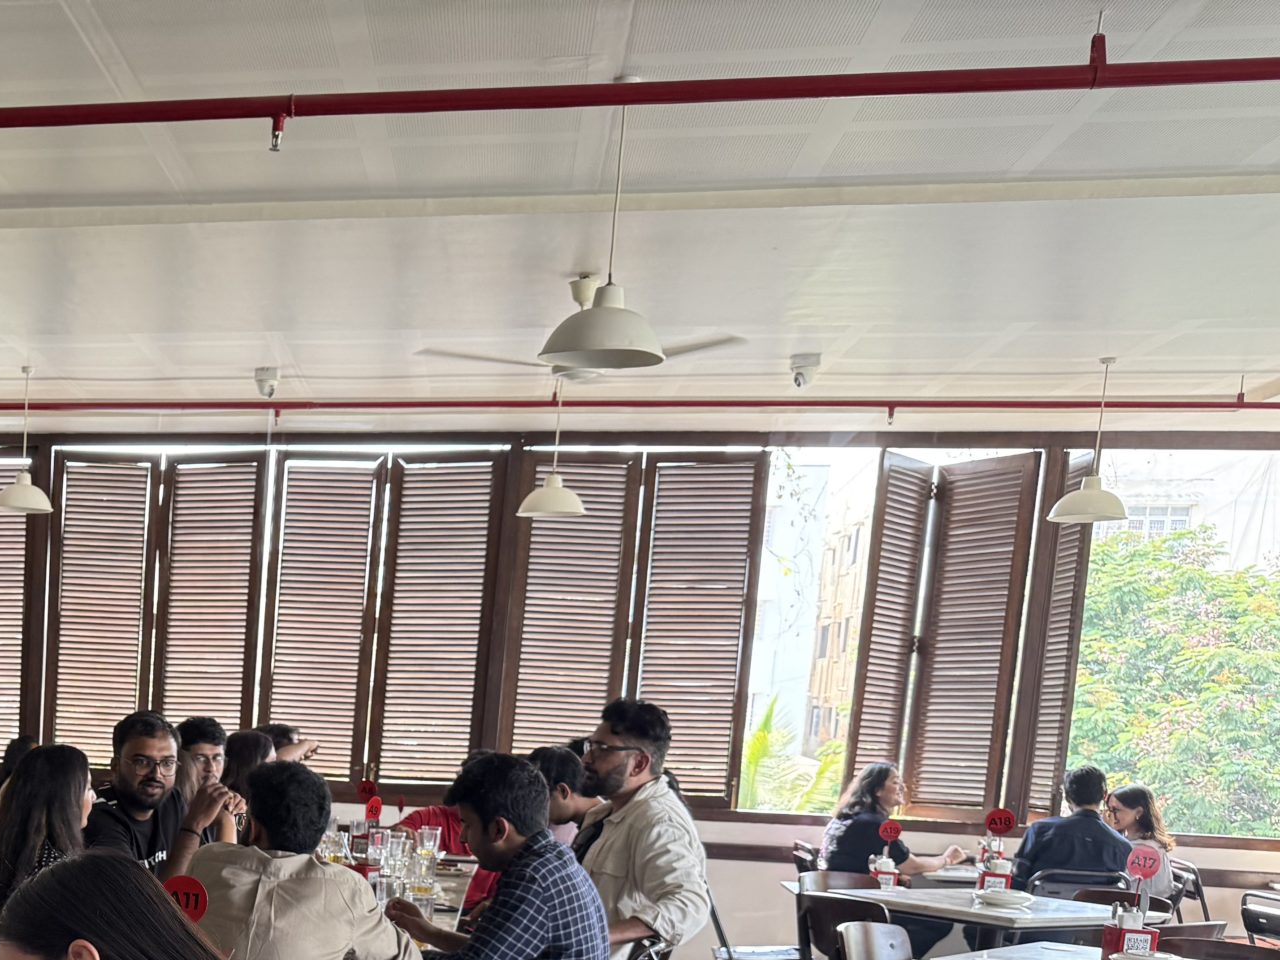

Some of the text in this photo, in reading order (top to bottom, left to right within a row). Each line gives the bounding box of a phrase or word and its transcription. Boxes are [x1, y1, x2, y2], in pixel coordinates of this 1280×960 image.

[989, 816, 1012, 829] A18
[882, 826, 899, 836] A19
[1130, 856, 1156, 870] A17
